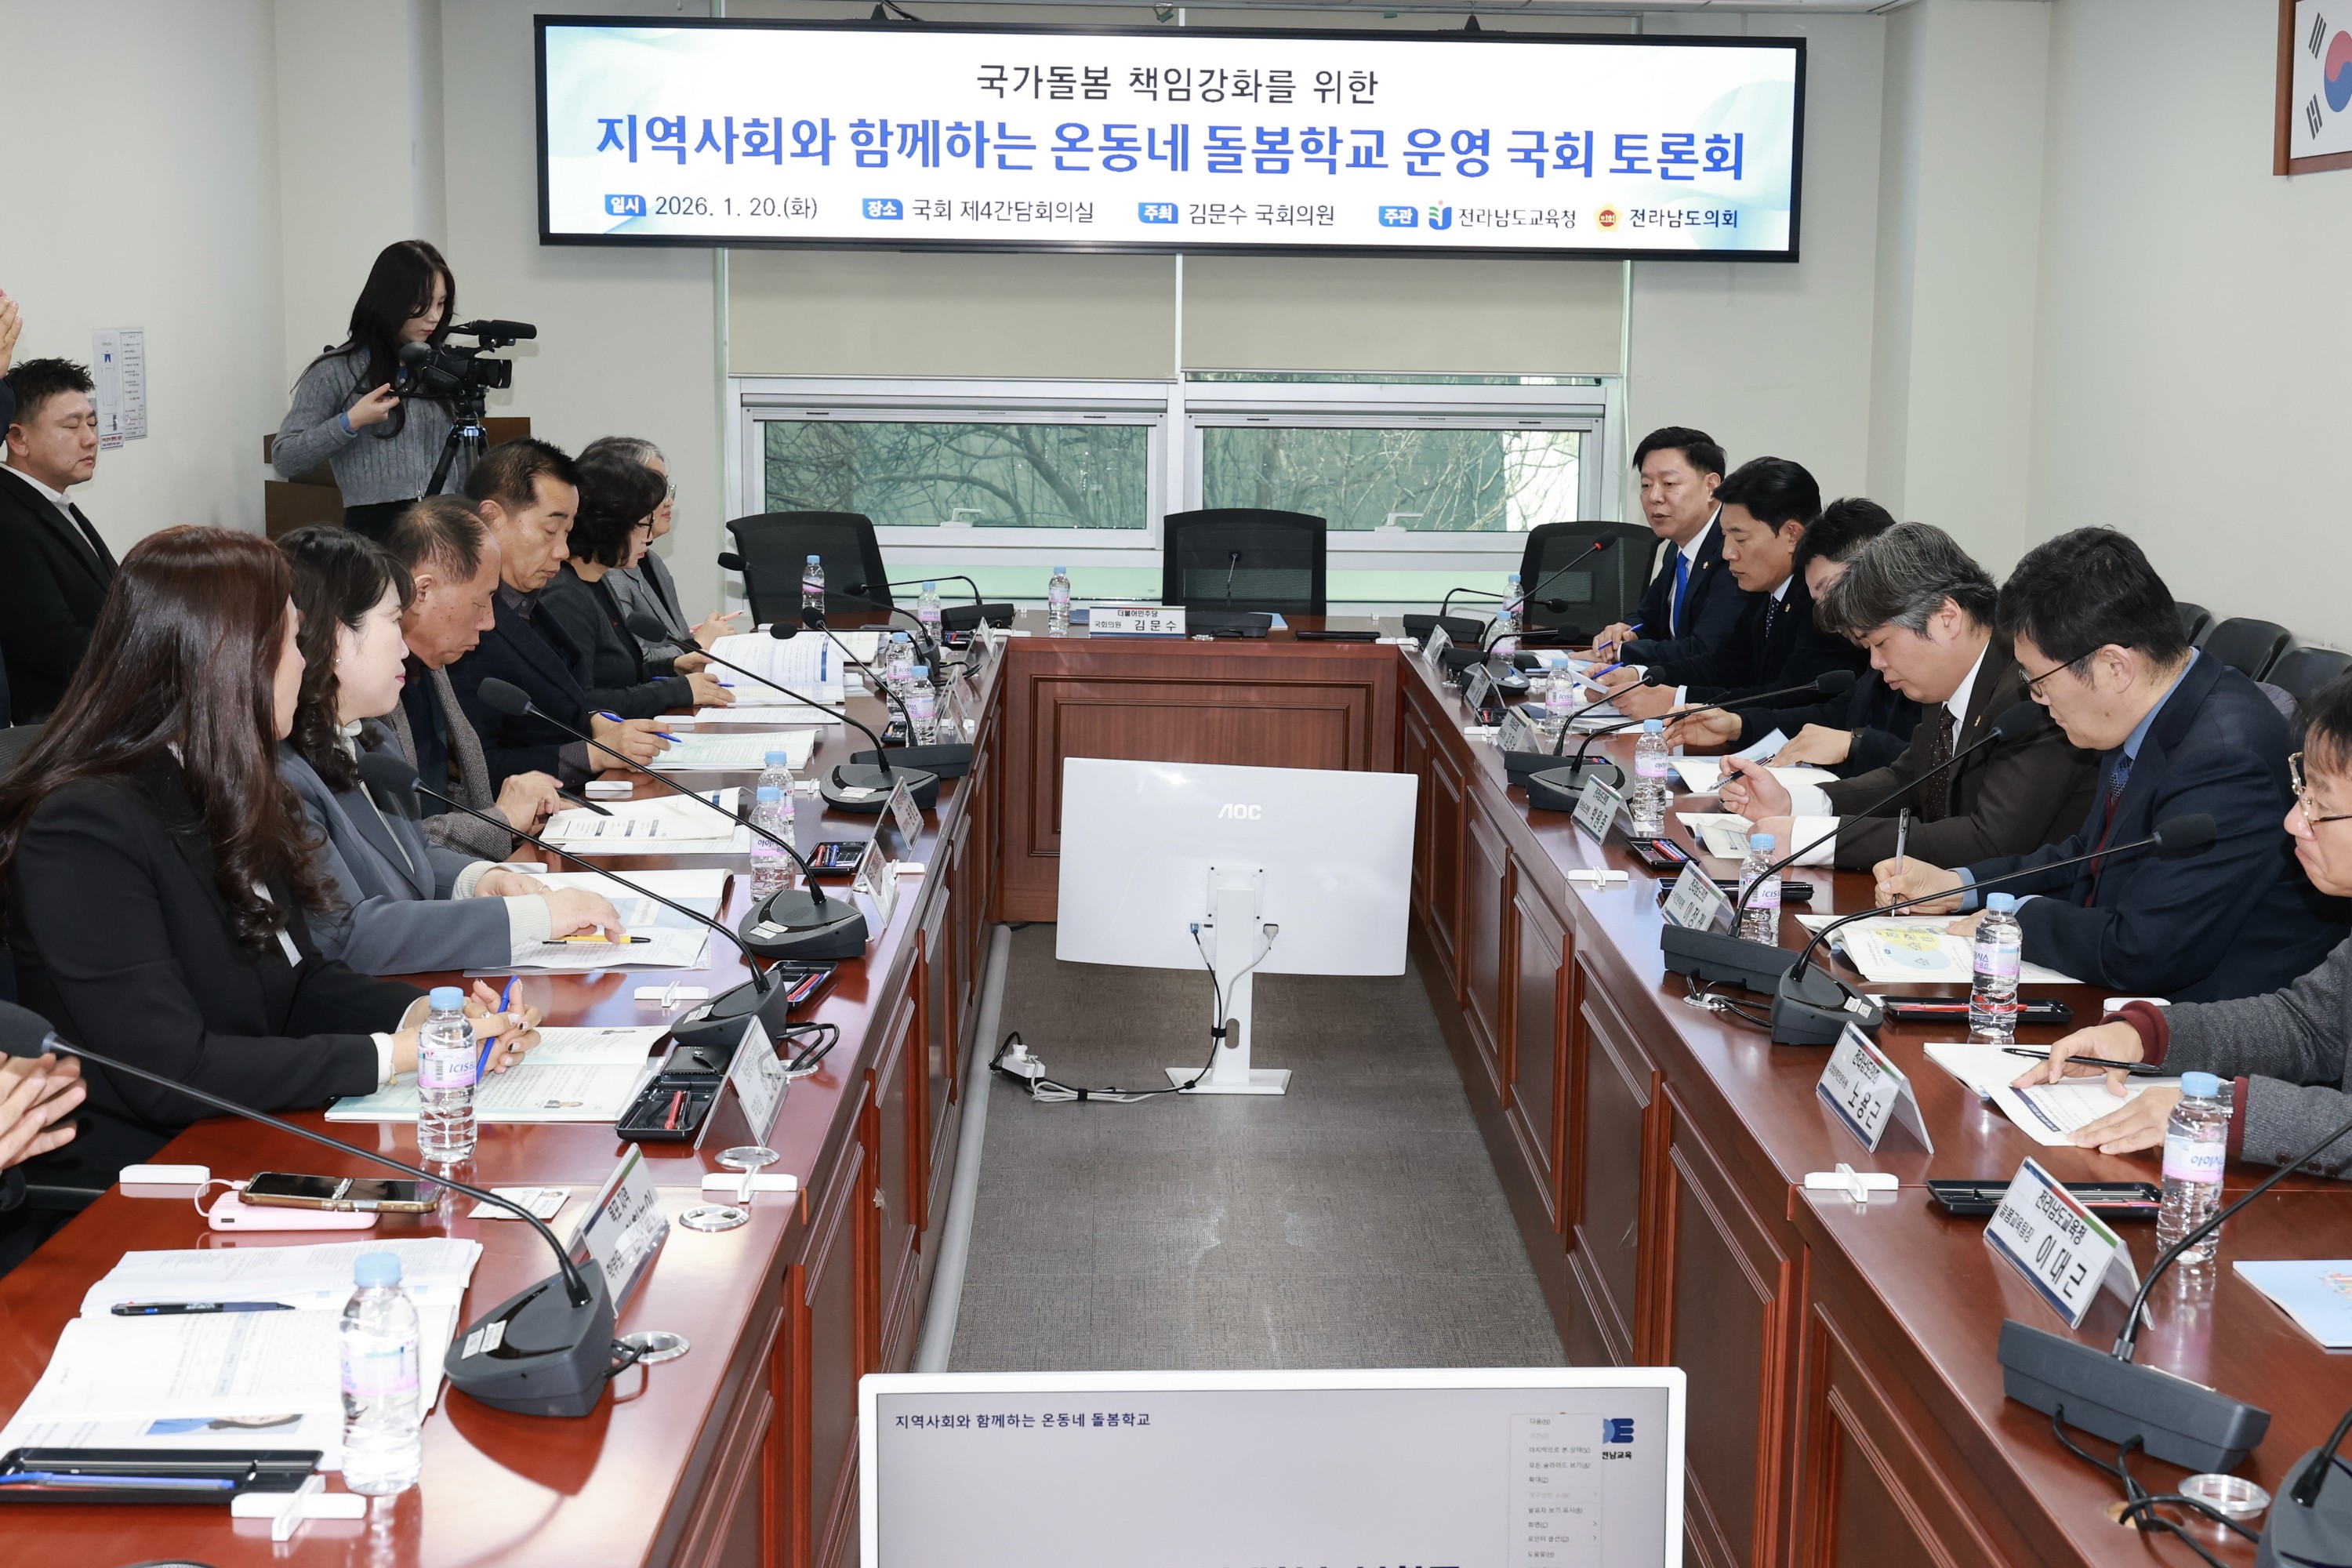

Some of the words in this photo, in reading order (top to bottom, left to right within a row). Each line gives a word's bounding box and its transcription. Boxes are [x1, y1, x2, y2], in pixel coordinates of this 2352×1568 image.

[976, 64, 1112, 100] 국가돌봄
[1129, 66, 1297, 104] 책임강화를
[1313, 69, 1378, 105] 위한
[596, 114, 837, 165] 지역사회와
[849, 118, 1037, 170] 함께하는
[1050, 122, 1189, 172] 온동네
[1203, 124, 1388, 175] 돌봄학교
[1402, 127, 1490, 178] 운영
[1507, 129, 1594, 179] 국회
[1609, 132, 1744, 181] 토론회
[610, 196, 641, 215] 일시
[655, 196, 715, 217] 2026.
[724, 197, 742, 218] 1.
[866, 199, 898, 218] 장소
[911, 198, 953, 222] 국회
[960, 198, 1094, 223] 제4간담회의실
[1143, 203, 1173, 222] 주최
[1188, 203, 1248, 225] 김문수
[1254, 203, 1335, 227] 국회의원
[1383, 206, 1414, 225] 주관
[1457, 208, 1577, 229] 전라남도교육청
[1628, 209, 1739, 230] 전라남도의회
[1218, 803, 1262, 821] AOC
[1847, 1080, 1882, 1131] 노용근
[2035, 1189, 2089, 1246] 전라남도교육청
[1998, 1203, 2035, 1243] 늘봄교육팀장
[2035, 1234, 2088, 1300] 이대근
[895, 1414, 971, 1430] 지역사회와
[975, 1414, 1036, 1429] 함께하는
[1041, 1413, 1086, 1428] 온동네
[1091, 1412, 1151, 1428] 돌봄학교
